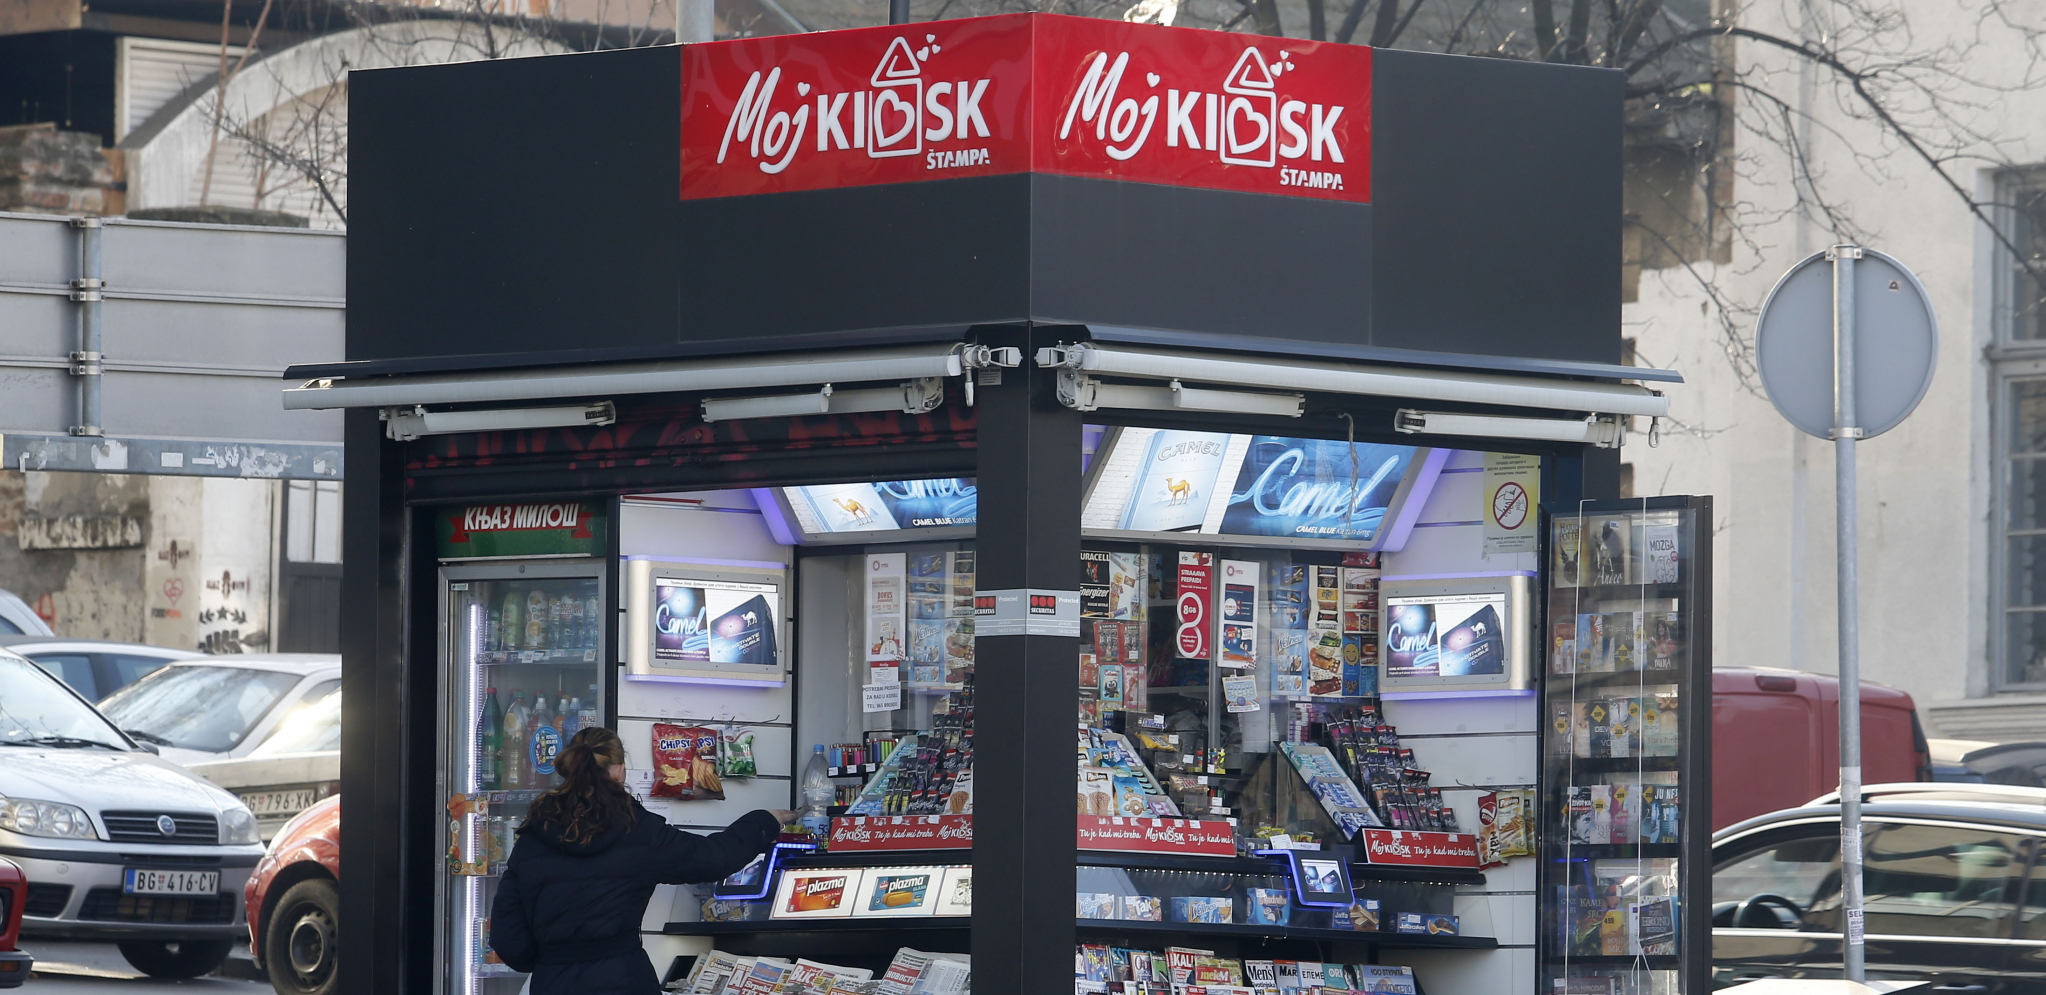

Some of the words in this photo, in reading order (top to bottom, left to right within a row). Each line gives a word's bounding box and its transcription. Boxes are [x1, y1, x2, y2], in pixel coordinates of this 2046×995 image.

[717, 66, 811, 174] Moj
[817, 48, 991, 158] KIOSK
[1060, 51, 1159, 161] Moj
[1167, 60, 1345, 168] KIOSK
[926, 147, 991, 170] ŠTAMPA
[1279, 166, 1344, 191] ŠTAMPA
[1157, 440, 1221, 461] CAMEL
[464, 505, 512, 530] КЊАЗ
[513, 503, 579, 528] МИЛОШ
[912, 517, 936, 526] CAMEL
[936, 517, 952, 525] BLUE
[1295, 525, 1318, 535] CAMEL
[1318, 527, 1336, 535] BLUE
[1649, 539, 1675, 551] MOZGA
[1080, 553, 1109, 561] URACELL
[1183, 604, 1197, 615] 8GB
[1098, 828, 1112, 838] kad
[1123, 828, 1141, 838] treba
[1206, 833, 1221, 843] kad
[1433, 845, 1447, 855] kad
[1458, 846, 1476, 856] treba
[136, 872, 156, 891] BG
[806, 877, 845, 896] plazma
[888, 876, 925, 894] plazma
[709, 899, 731, 914] Tak
[1134, 899, 1152, 914] Tak
[1279, 966, 1296, 977] MAR
[744, 980, 772, 993] Srpski
